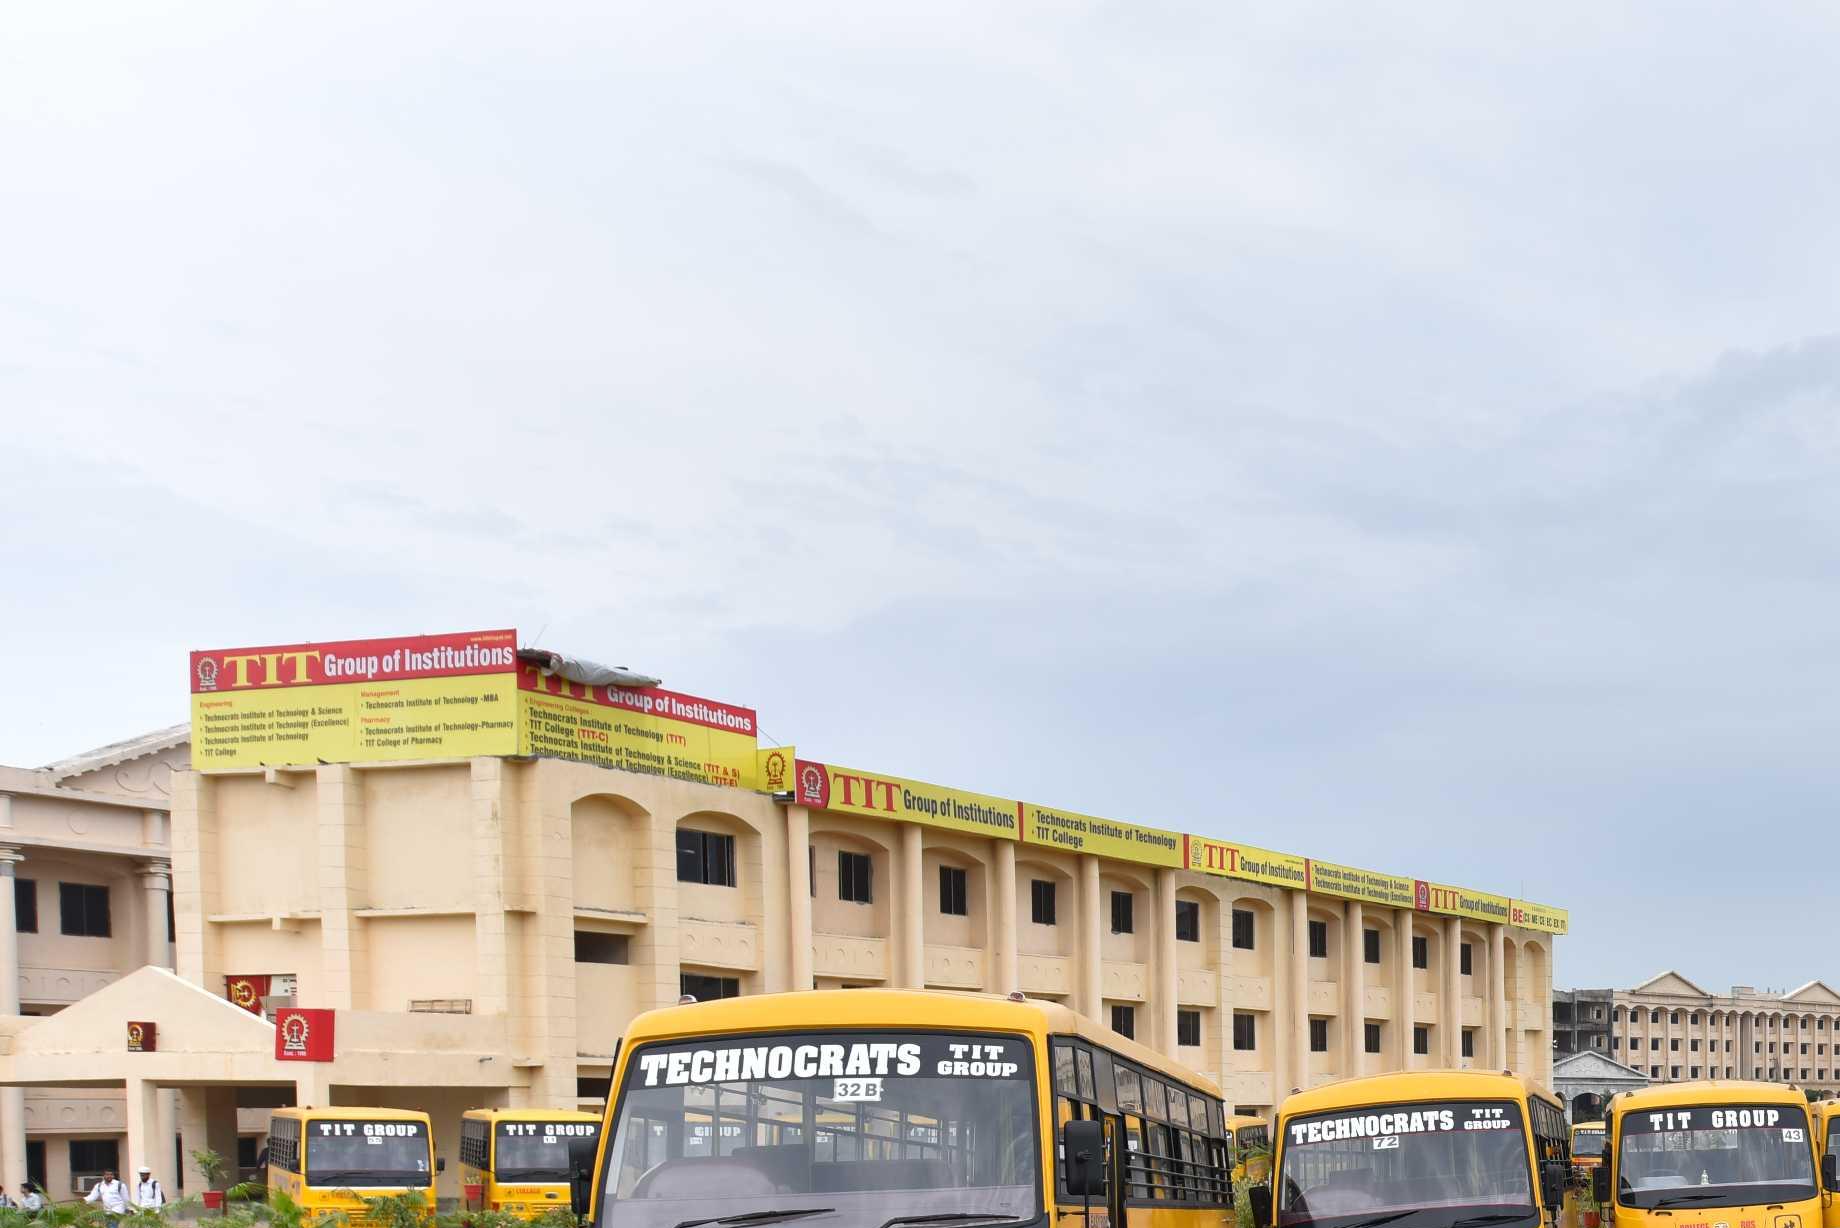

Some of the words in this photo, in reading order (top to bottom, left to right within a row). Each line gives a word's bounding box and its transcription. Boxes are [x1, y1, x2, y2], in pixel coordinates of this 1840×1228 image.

[223, 650, 321, 687] TIT
[324, 653, 378, 679] Group
[382, 649, 401, 673] of
[404, 644, 513, 671] Institutions
[366, 700, 404, 710] Technocrats
[406, 698, 432, 708] Institute
[435, 697, 441, 706] of
[443, 694, 478, 705] Technology
[607, 685, 653, 713] Group
[655, 696, 671, 713] of
[672, 697, 752, 732] Institutions
[205, 712, 239, 722] Technocrats
[241, 711, 266, 720] Institute
[276, 708, 309, 718] Technology
[318, 706, 343, 715] Science
[205, 724, 239, 734] Technocrats
[241, 723, 266, 732] Institute
[276, 720, 309, 730] Technology
[365, 726, 404, 736] Technocrats
[406, 725, 432, 734] Institute
[434, 723, 441, 732] of
[529, 707, 578, 725] Technocrats
[580, 716, 612, 731] Institute
[614, 723, 622, 733] of
[624, 724, 664, 743] Technology
[666, 733, 687, 747] (TIT)
[529, 719, 542, 730] TIT
[544, 722, 574, 736] College
[205, 736, 239, 746] Technocrats
[241, 735, 266, 744] Institute
[276, 732, 309, 742] Technology
[376, 738, 400, 748] College
[411, 735, 442, 745] Pharmacy
[215, 748, 237, 757] College
[529, 731, 578, 749] Technocrats
[580, 741, 613, 755] Institute
[615, 747, 623, 756] of
[624, 747, 665, 765] Technology
[667, 754, 673, 765] &
[675, 756, 701, 770] Science
[833, 773, 902, 813] TIT
[904, 789, 938, 819] Group
[940, 798, 951, 817] of
[953, 800, 1015, 830] Institutions
[1036, 810, 1087, 833] Technocrats
[1089, 821, 1122, 840] Institute
[1125, 829, 1133, 841] of
[1135, 830, 1177, 850] Technology
[1036, 826, 1050, 841] TIT
[1052, 829, 1084, 848] College
[1204, 843, 1240, 872] TIT
[1240, 856, 1260, 876] Group
[1261, 861, 1268, 875] of
[1268, 862, 1305, 882] Institutions
[1431, 887, 1460, 911] TIT
[1459, 895, 1474, 912] Group
[1480, 899, 1507, 917] Institutions
[1512, 907, 1523, 923] BE
[949, 1044, 1004, 1060] TIT
[640, 1043, 921, 1087] TECHNOCRATS
[937, 1061, 1018, 1077] GROUP
[838, 1083, 862, 1097] 32
[865, 1083, 878, 1097] B
[1472, 1108, 1504, 1119] TIT
[1650, 1111, 1692, 1131] TIT
[1711, 1109, 1779, 1128] GROUP
[320, 1123, 356, 1136] TIT
[363, 1123, 418, 1137] GROUP
[506, 1124, 537, 1136] TIT
[545, 1124, 595, 1136] GROUP
[1291, 1110, 1455, 1145] TECHNOCRATS
[1464, 1119, 1511, 1130] GROUP
[1375, 1137, 1398, 1148] 72
[1784, 1131, 1801, 1141] 43
